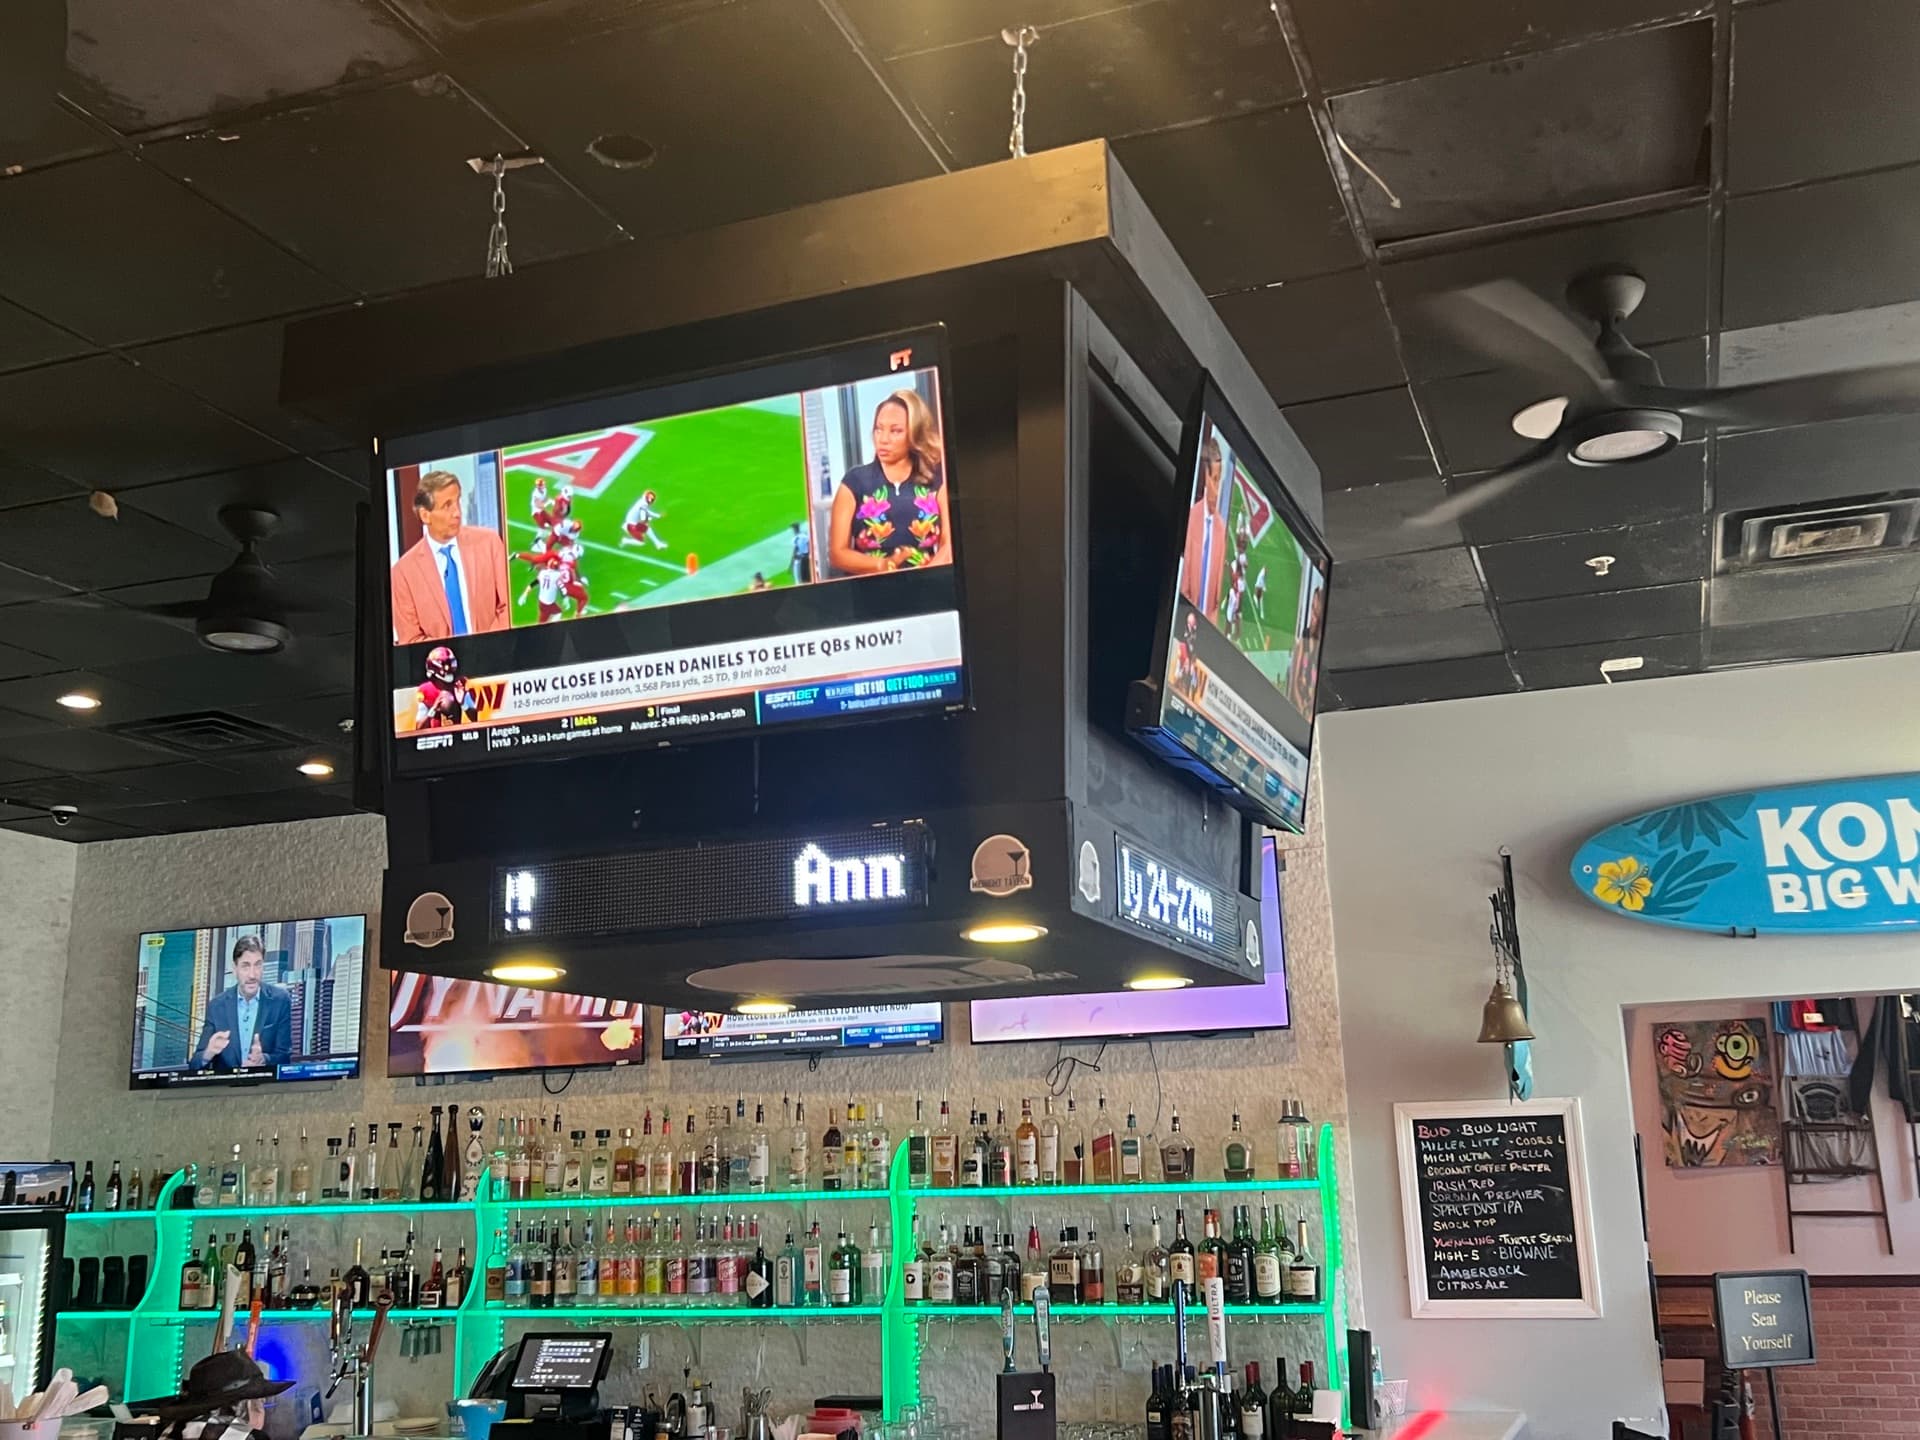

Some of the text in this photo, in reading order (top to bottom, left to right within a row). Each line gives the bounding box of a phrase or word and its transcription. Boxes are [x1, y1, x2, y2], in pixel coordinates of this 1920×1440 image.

[513, 630, 904, 697] HOW CLOSE IS JAYDEN DANIELS TO ELITE QBs NOW?
[513, 699, 531, 709] 12-5
[532, 694, 560, 706] record
[562, 693, 570, 702] in
[571, 690, 598, 701] rookie
[660, 679, 681, 690] Pass
[703, 674, 714, 684] 25
[740, 669, 752, 679] Int
[754, 668, 763, 677] in
[765, 664, 787, 676] 2024
[765, 687, 820, 704] ESPN BET
[574, 707, 655, 726] Mets 3
[491, 718, 568, 737] Angels 2
[417, 731, 479, 750] ESPN MLB
[1767, 867, 1870, 914] BIG
[1417, 1121, 1538, 1139] BUD BUD LIGHT
[1420, 1140, 1466, 1151] MILLER
[1471, 1136, 1500, 1148] LITE
[1515, 1135, 1553, 1146] COORS
[1423, 1148, 1554, 1165] MICH ULTRA STELLA
[1509, 1161, 1551, 1173] PORTER
[1432, 1178, 1496, 1191] IRISH RED
[1428, 1189, 1545, 1203] CORONA PREMIER
[1502, 1200, 1524, 1215] IPA
[1432, 1217, 1497, 1232] SHOCK TOP
[1439, 1264, 1528, 1280] AMBERBOCK
[1436, 1279, 1509, 1292] CITRUS ALE
[1210, 1283, 1220, 1315] ULTRA
[1743, 1289, 1782, 1305] Please
[1751, 1311, 1778, 1327] Seat
[1741, 1333, 1795, 1351] Yourself
